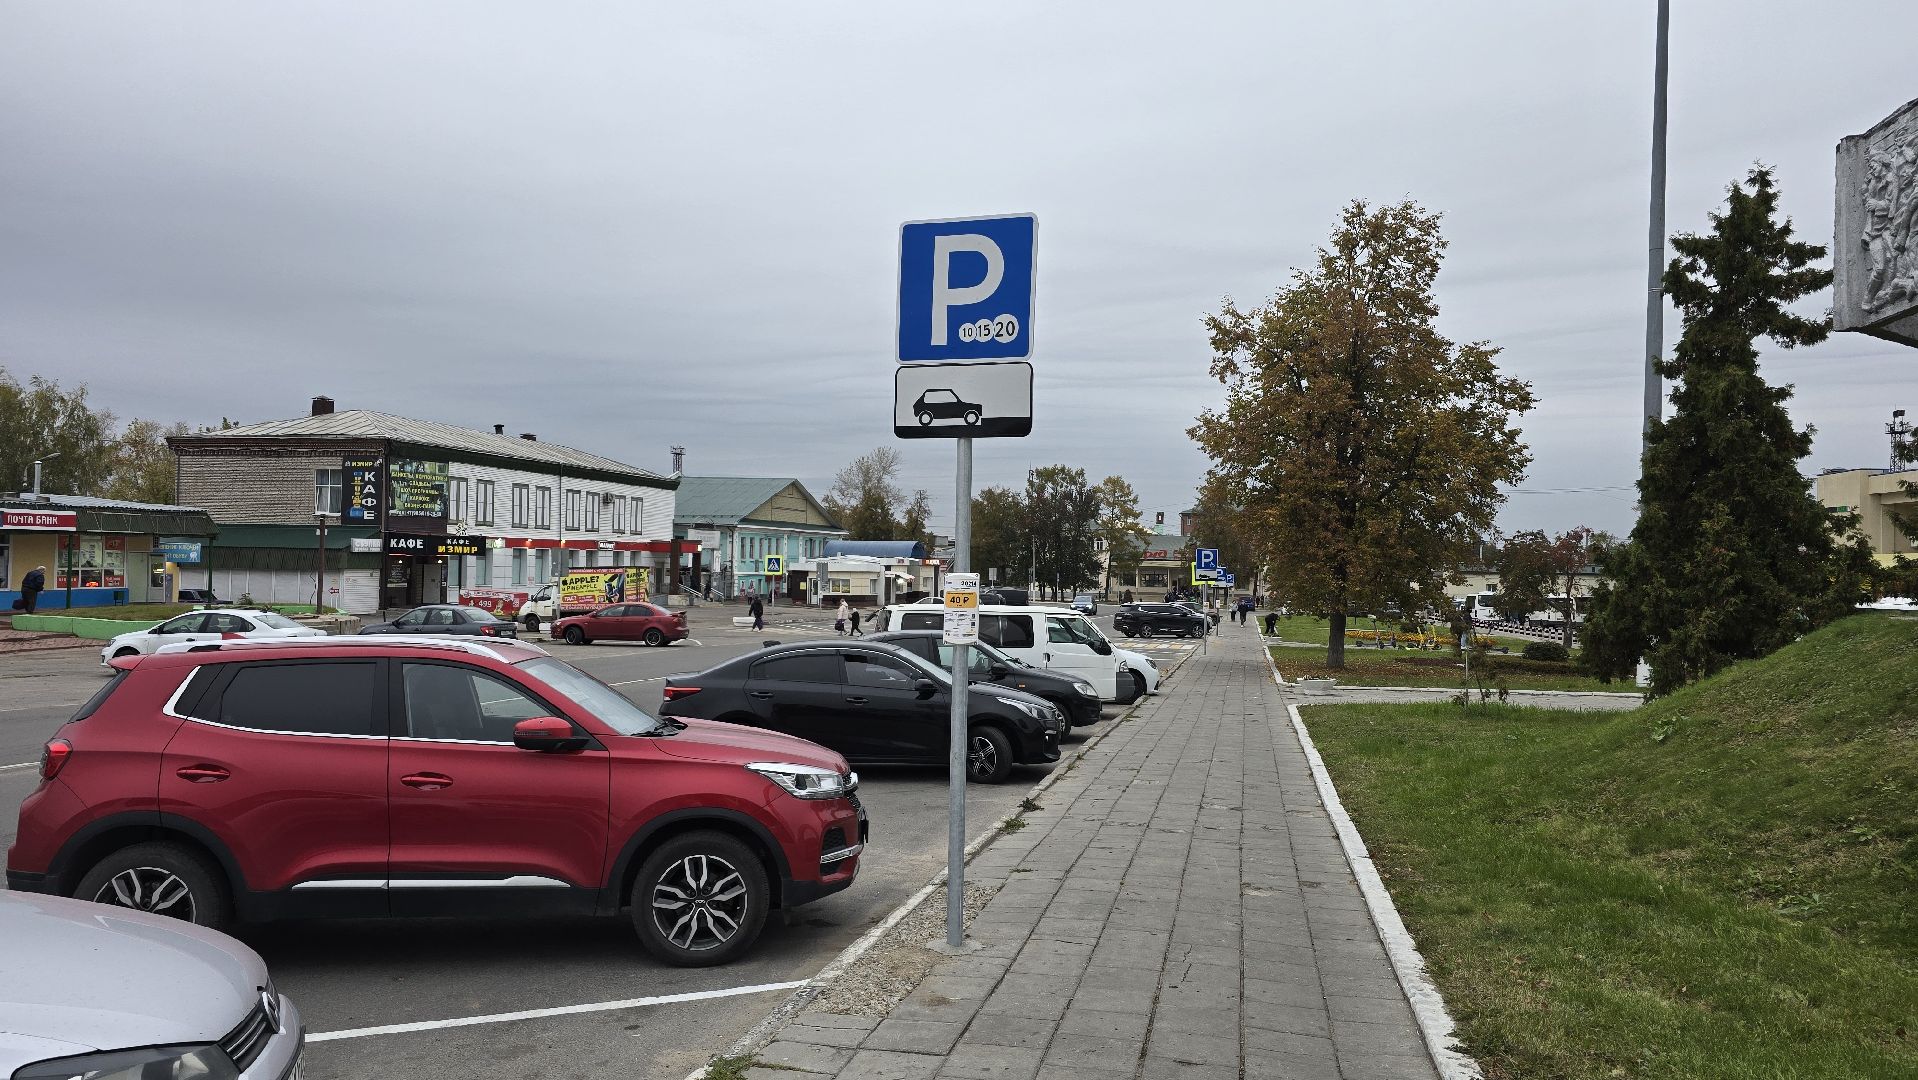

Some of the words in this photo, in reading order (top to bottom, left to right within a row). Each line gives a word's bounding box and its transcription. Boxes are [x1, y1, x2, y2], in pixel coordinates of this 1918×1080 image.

[930, 233, 1005, 346] P
[962, 327, 973, 338] 10
[978, 324, 991, 337] 15
[995, 320, 1016, 338] 20
[361, 471, 377, 520] КАФЕ
[7, 514, 34, 524] ПОЧТА
[35, 515, 58, 525] БАНК
[389, 538, 424, 549] КАФЕ
[437, 545, 478, 554] ИЗМИР
[1201, 550, 1214, 568] P
[568, 575, 600, 586] APPLE?
[566, 583, 598, 592] PINEAPPLE
[950, 596, 961, 604] 40
